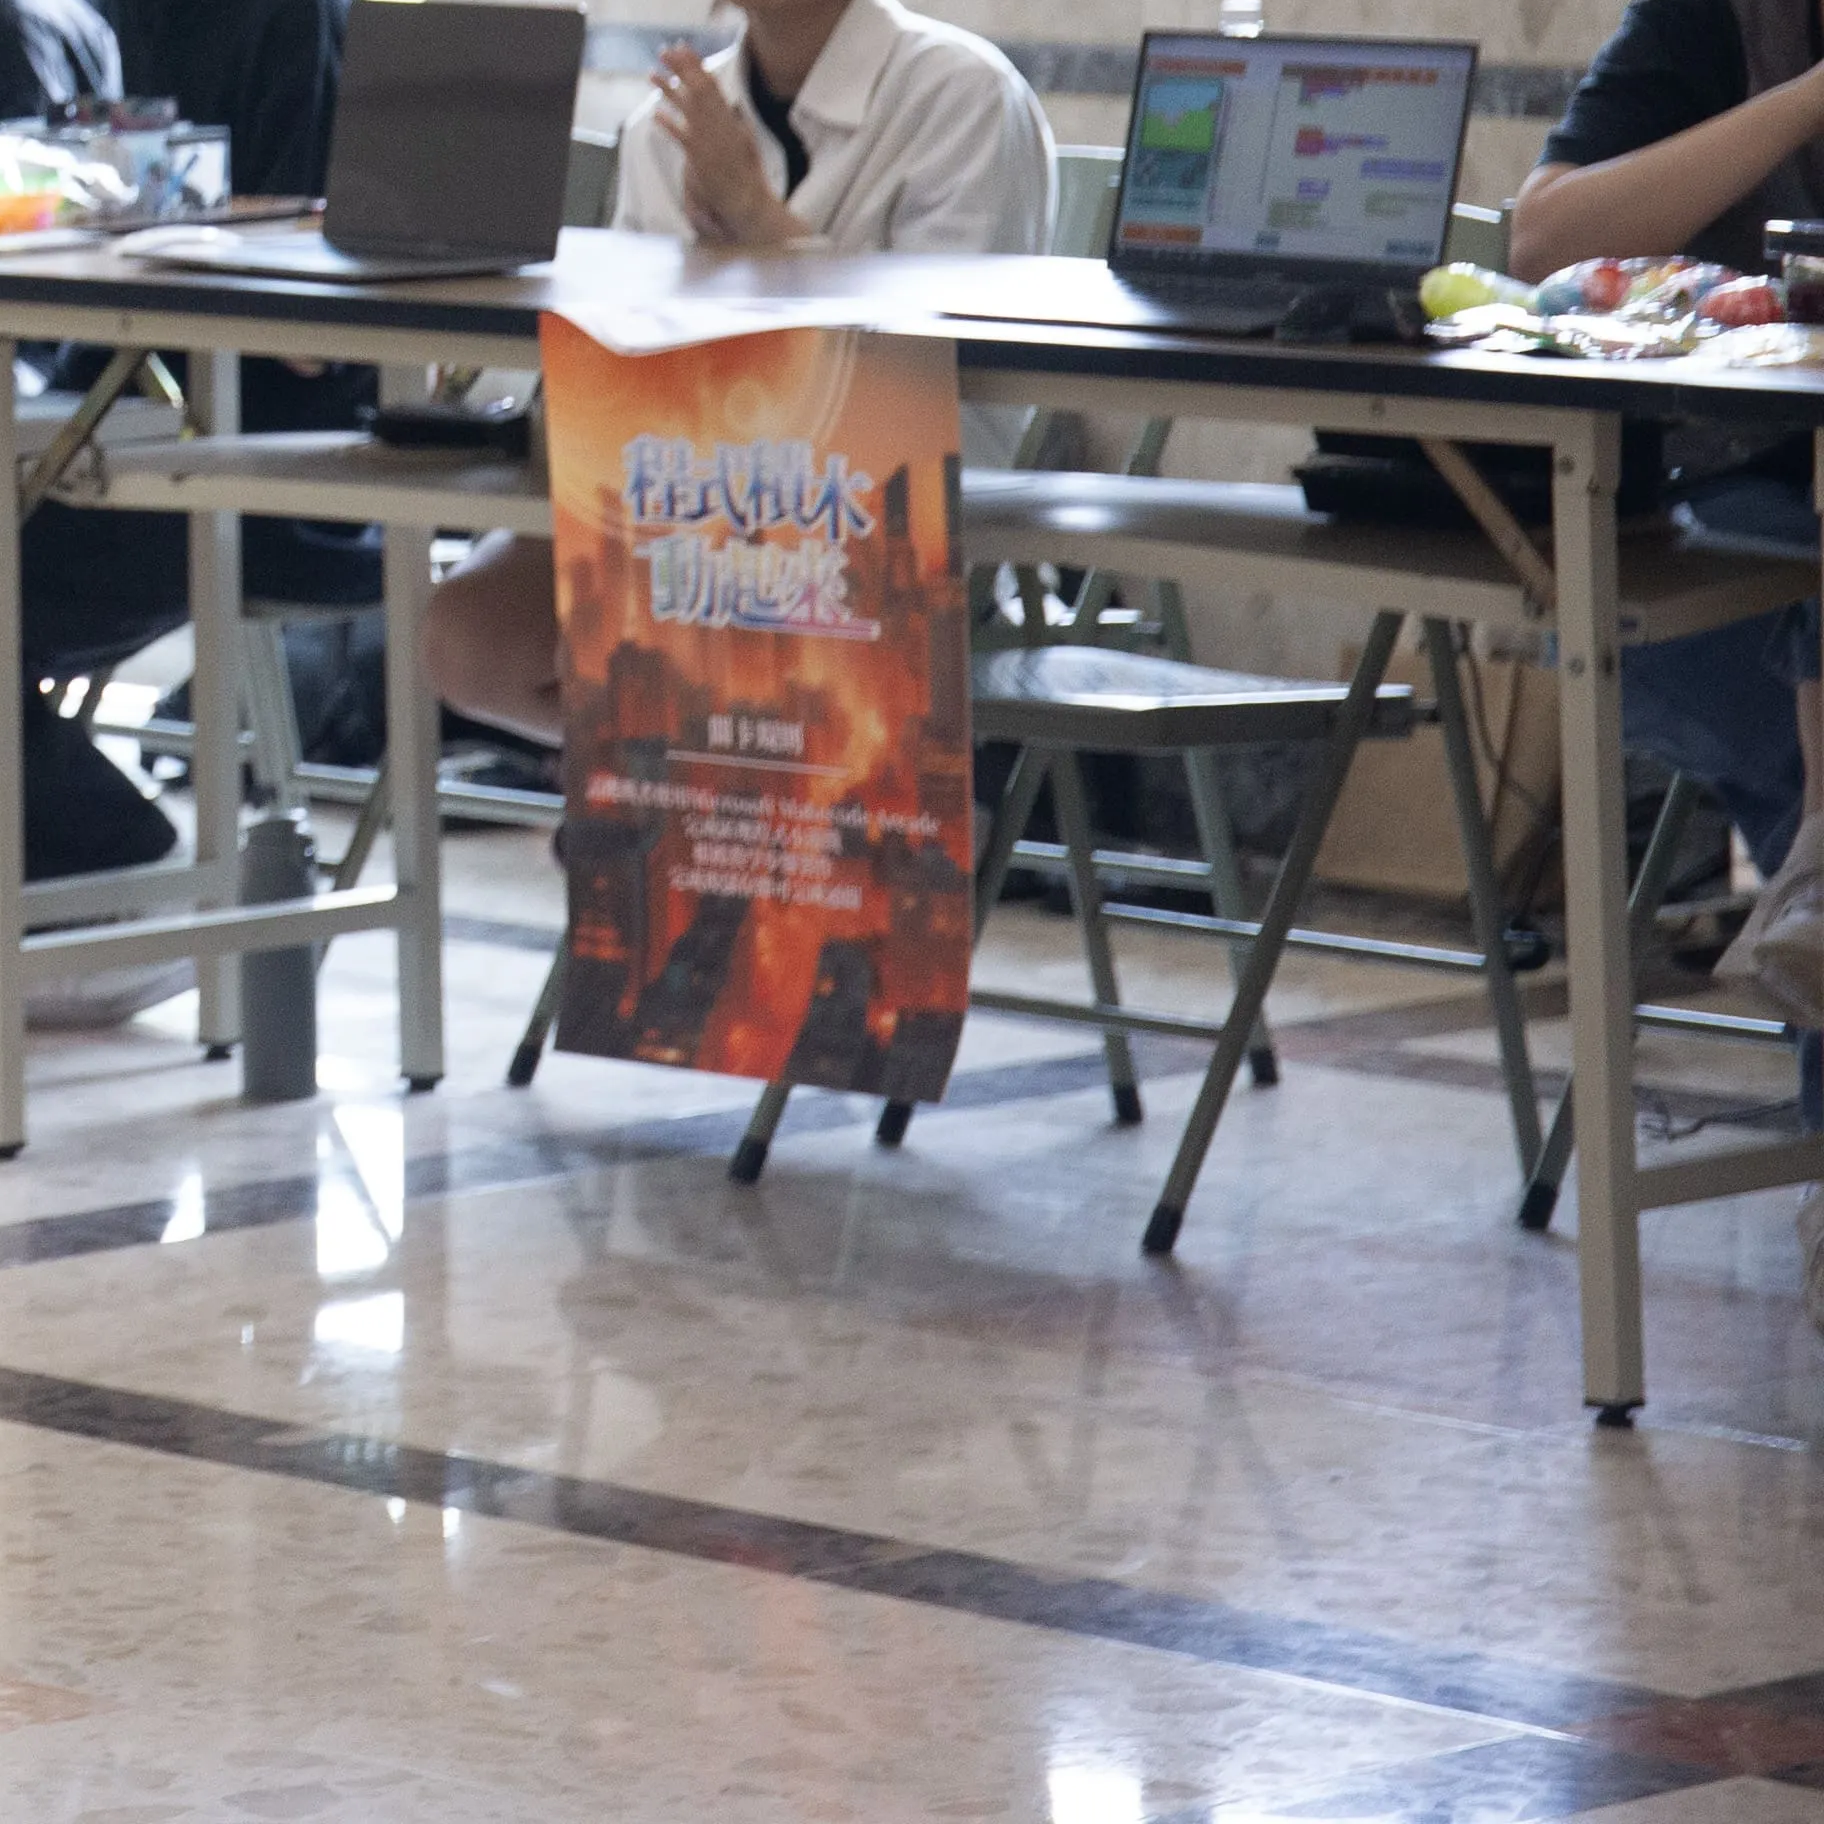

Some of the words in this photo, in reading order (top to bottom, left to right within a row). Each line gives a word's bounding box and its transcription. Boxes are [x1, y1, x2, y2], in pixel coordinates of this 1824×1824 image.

[623, 434, 877, 544] 程式積木
[632, 532, 881, 641] 動起來
